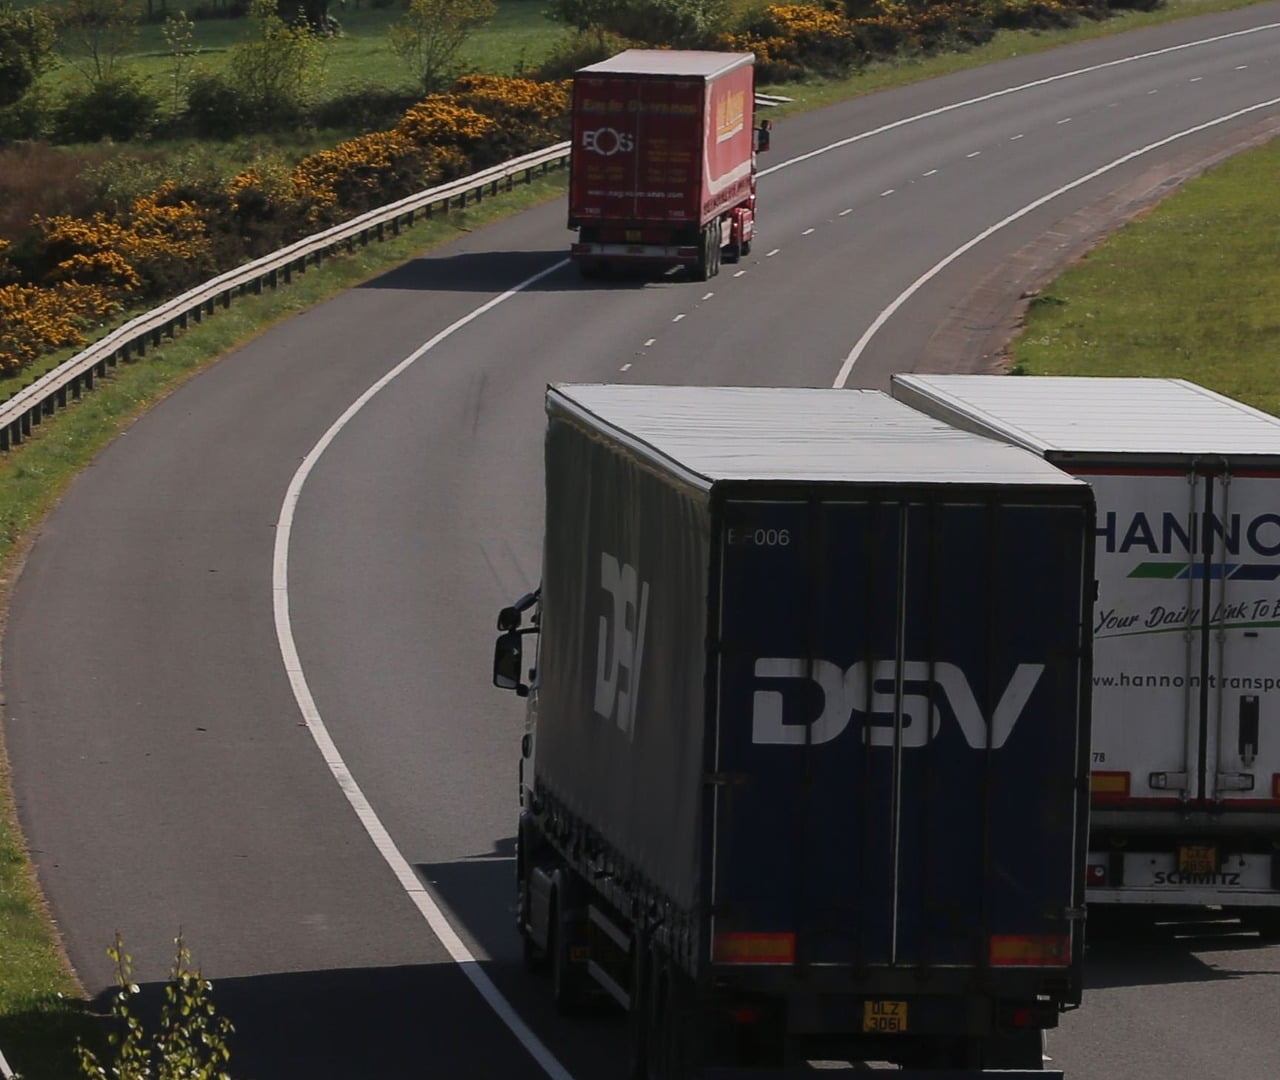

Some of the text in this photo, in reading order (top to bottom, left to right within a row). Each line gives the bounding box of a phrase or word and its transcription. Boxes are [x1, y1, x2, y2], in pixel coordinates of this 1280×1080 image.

[582, 127, 634, 156] EOS
[1094, 609, 1140, 634] Your
[1210, 602, 1247, 624] Link
[1252, 599, 1270, 620] To
[593, 551, 650, 745] DSV
[750, 657, 1047, 750] DSV
[1154, 871, 1240, 885] SCHMITZ
